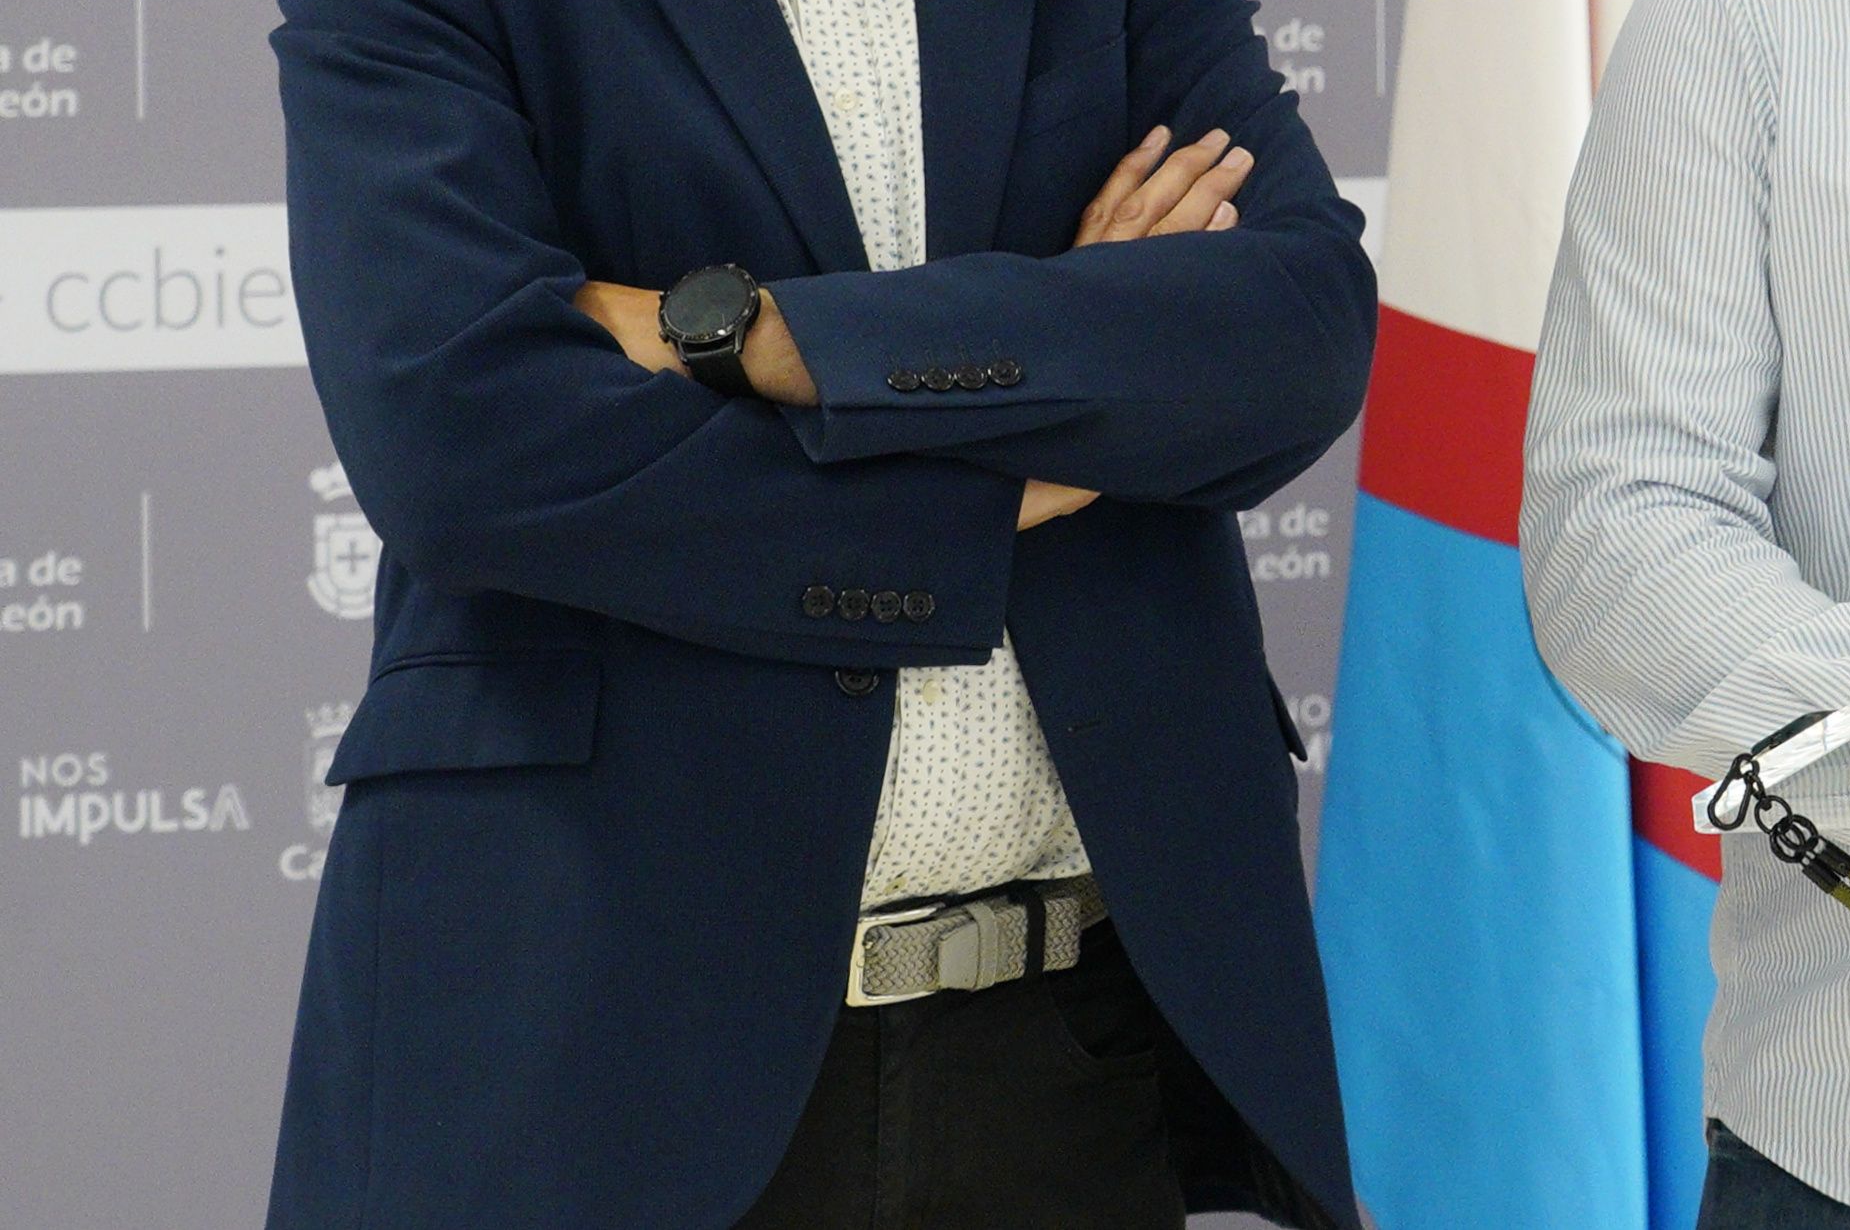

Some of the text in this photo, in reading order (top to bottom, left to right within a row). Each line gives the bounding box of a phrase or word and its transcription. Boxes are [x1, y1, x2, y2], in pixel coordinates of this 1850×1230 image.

[1275, 20, 1325, 53] de
[23, 40, 78, 74] de
[1280, 505, 1330, 538] de
[29, 553, 83, 587] de
[21, 753, 110, 788] NOS
